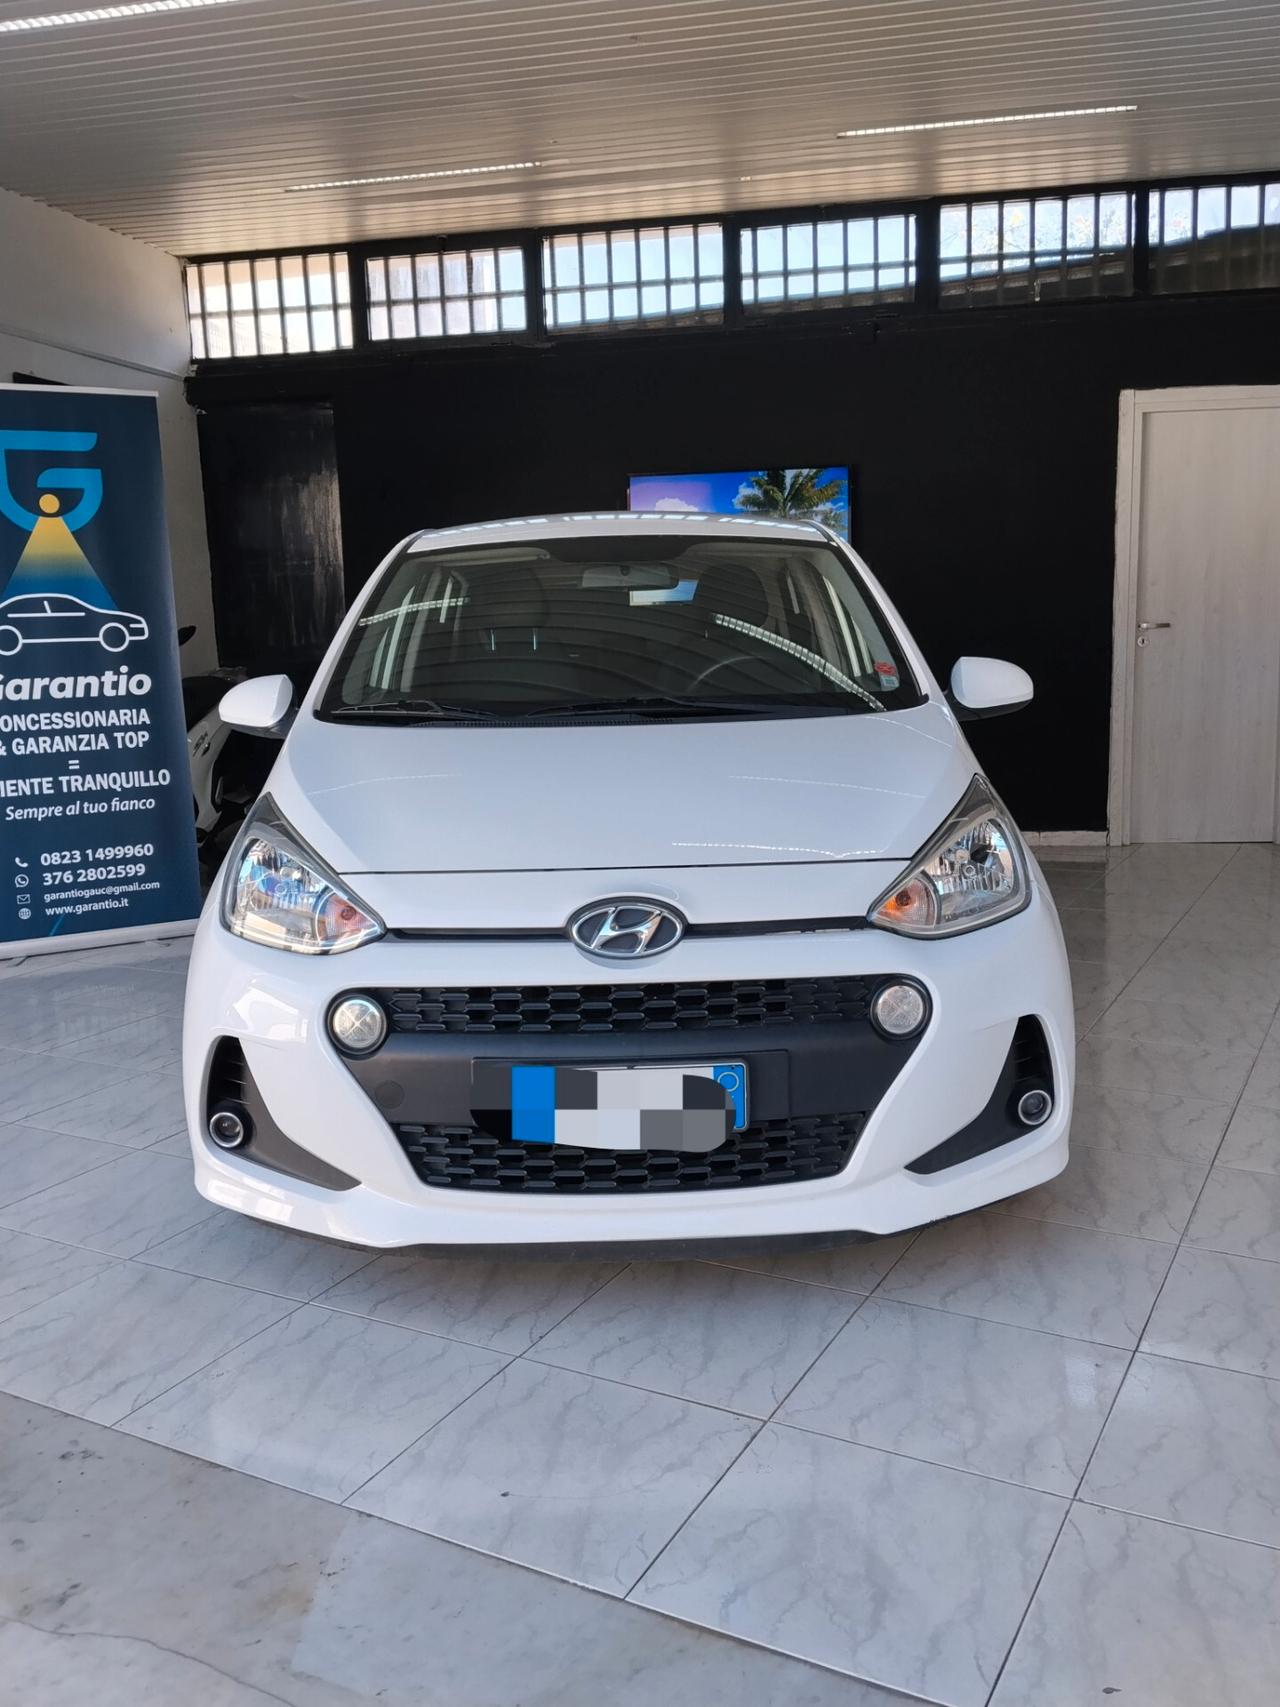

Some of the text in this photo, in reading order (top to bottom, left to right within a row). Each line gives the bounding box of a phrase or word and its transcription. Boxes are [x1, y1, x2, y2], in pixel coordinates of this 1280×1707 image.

[0, 665, 152, 701] arantio
[12, 733, 109, 755] GARANZIA
[114, 731, 149, 748] TOP
[59, 769, 170, 793] TRANQUILLO
[5, 797, 156, 821] Sempre al tuo fianco
[40, 843, 154, 866] 0823 1499960
[42, 863, 146, 886] 376 2802599
[44, 881, 160, 903] garantiogauc@gmail.com
[45, 898, 129, 916] www.garantio.it
